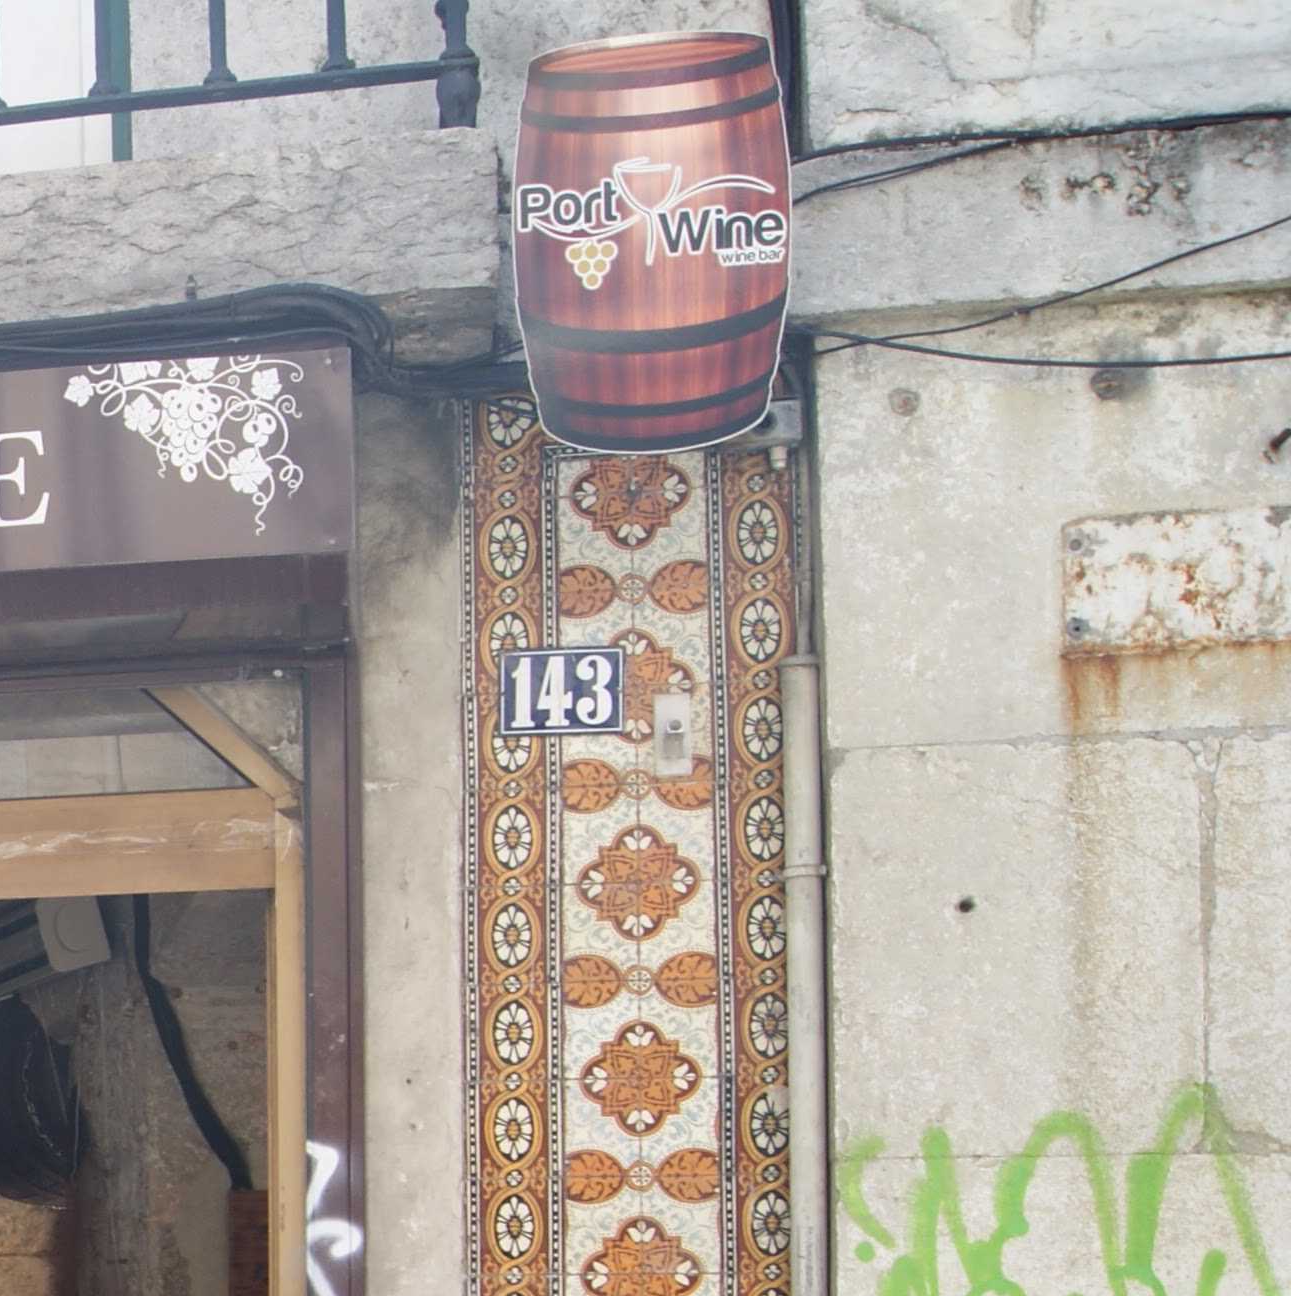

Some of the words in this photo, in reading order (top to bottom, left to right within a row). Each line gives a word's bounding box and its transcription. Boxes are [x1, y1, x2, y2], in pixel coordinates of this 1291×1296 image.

[518, 179, 618, 231] Port
[656, 206, 786, 254] Wine
[720, 252, 757, 264] wine
[758, 249, 784, 262] bar
[510, 654, 613, 728] 143
